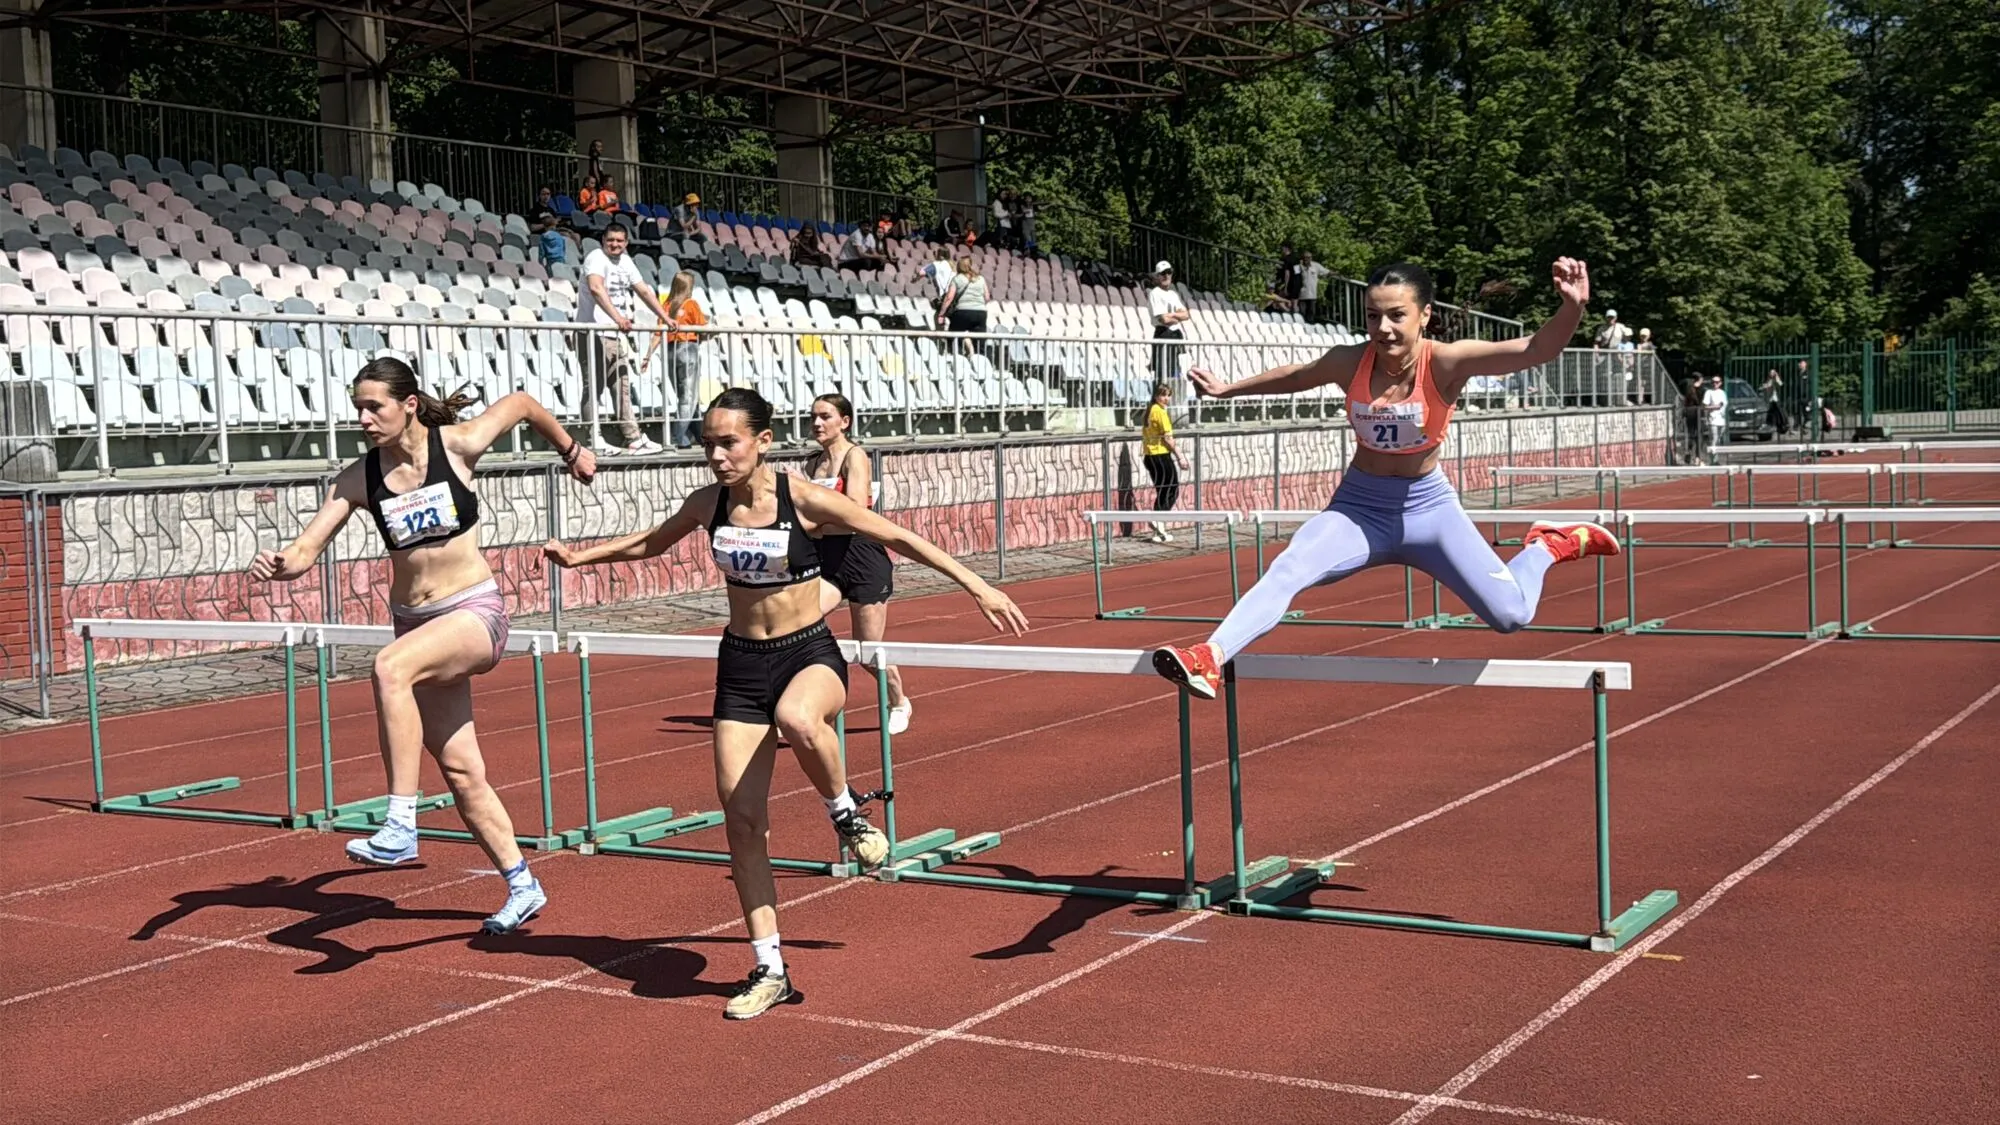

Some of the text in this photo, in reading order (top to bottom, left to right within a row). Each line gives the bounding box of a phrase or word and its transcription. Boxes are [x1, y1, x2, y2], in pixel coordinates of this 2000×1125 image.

[1373, 424, 1398, 442] 27
[402, 507, 441, 535] 123
[728, 550, 769, 572] 122
